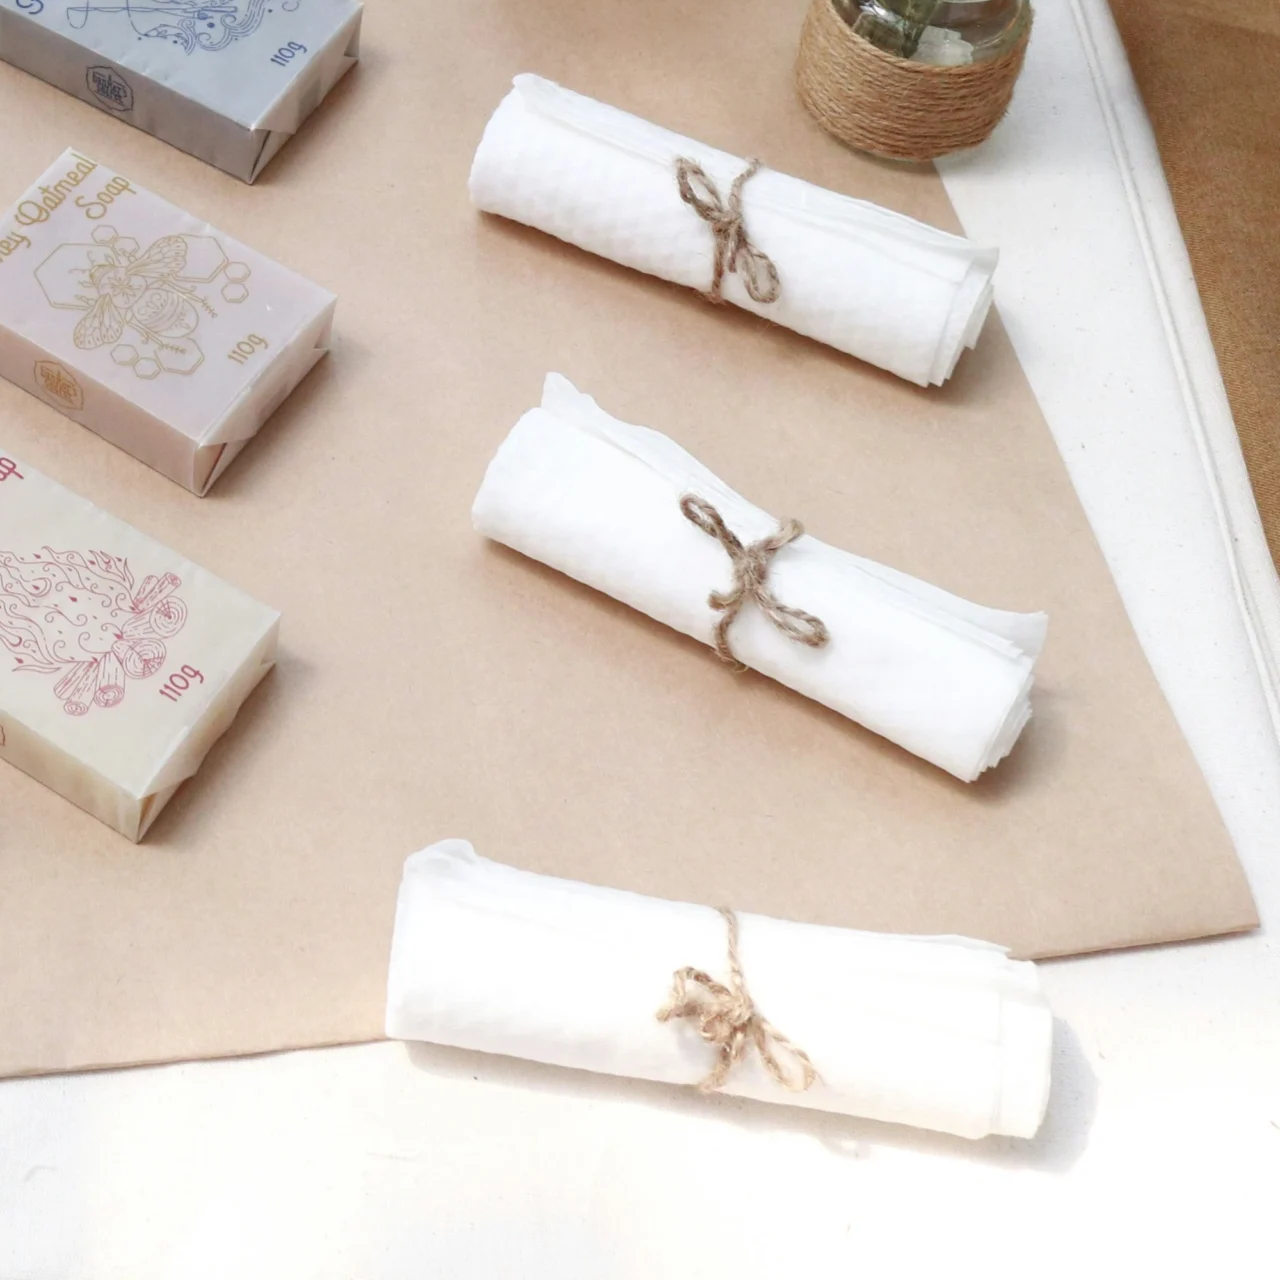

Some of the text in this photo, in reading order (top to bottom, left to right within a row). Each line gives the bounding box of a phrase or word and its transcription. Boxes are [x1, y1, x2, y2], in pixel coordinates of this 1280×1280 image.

[269, 40, 308, 67] 110g
[15, 152, 98, 226] Oatmeal
[75, 175, 137, 220] Soap
[228, 333, 269, 365] 110g
[159, 664, 204, 702] 110g
